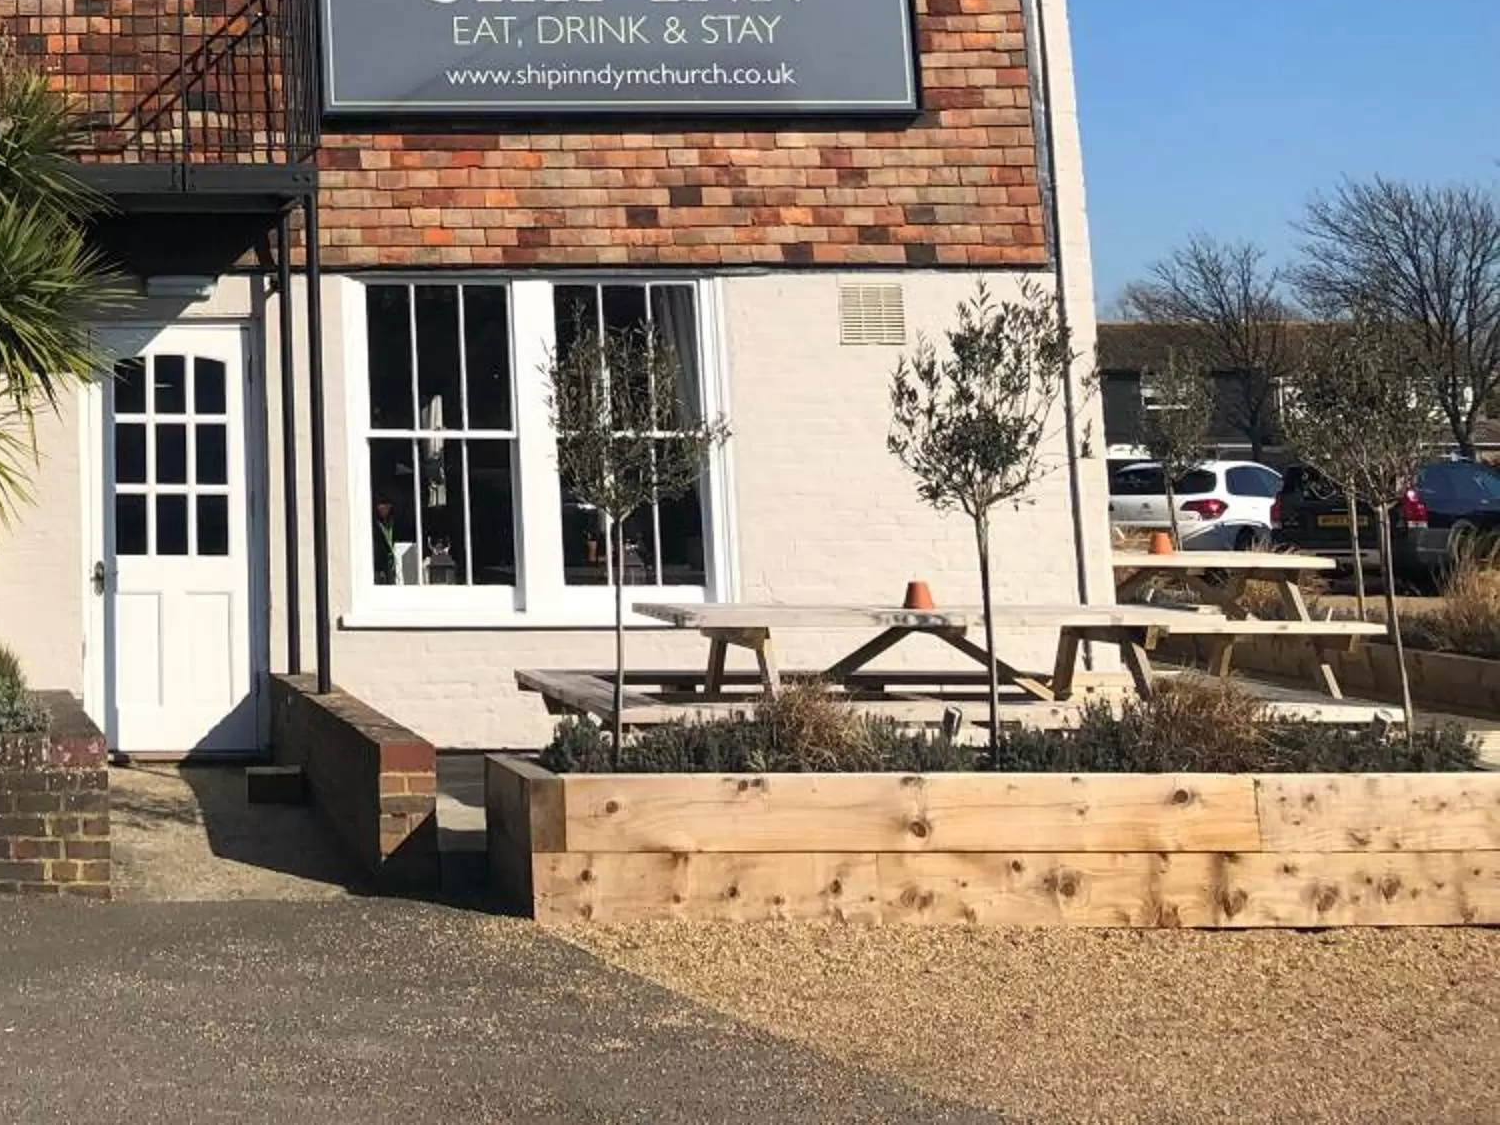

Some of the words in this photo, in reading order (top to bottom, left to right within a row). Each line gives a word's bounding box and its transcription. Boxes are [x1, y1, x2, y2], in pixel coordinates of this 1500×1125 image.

[453, 15, 523, 48] EAT,
[537, 15, 649, 44] DRINK
[663, 15, 688, 44] &
[701, 15, 782, 44] STAY
[446, 63, 796, 90] www.shipinndymchurch.co.uk
